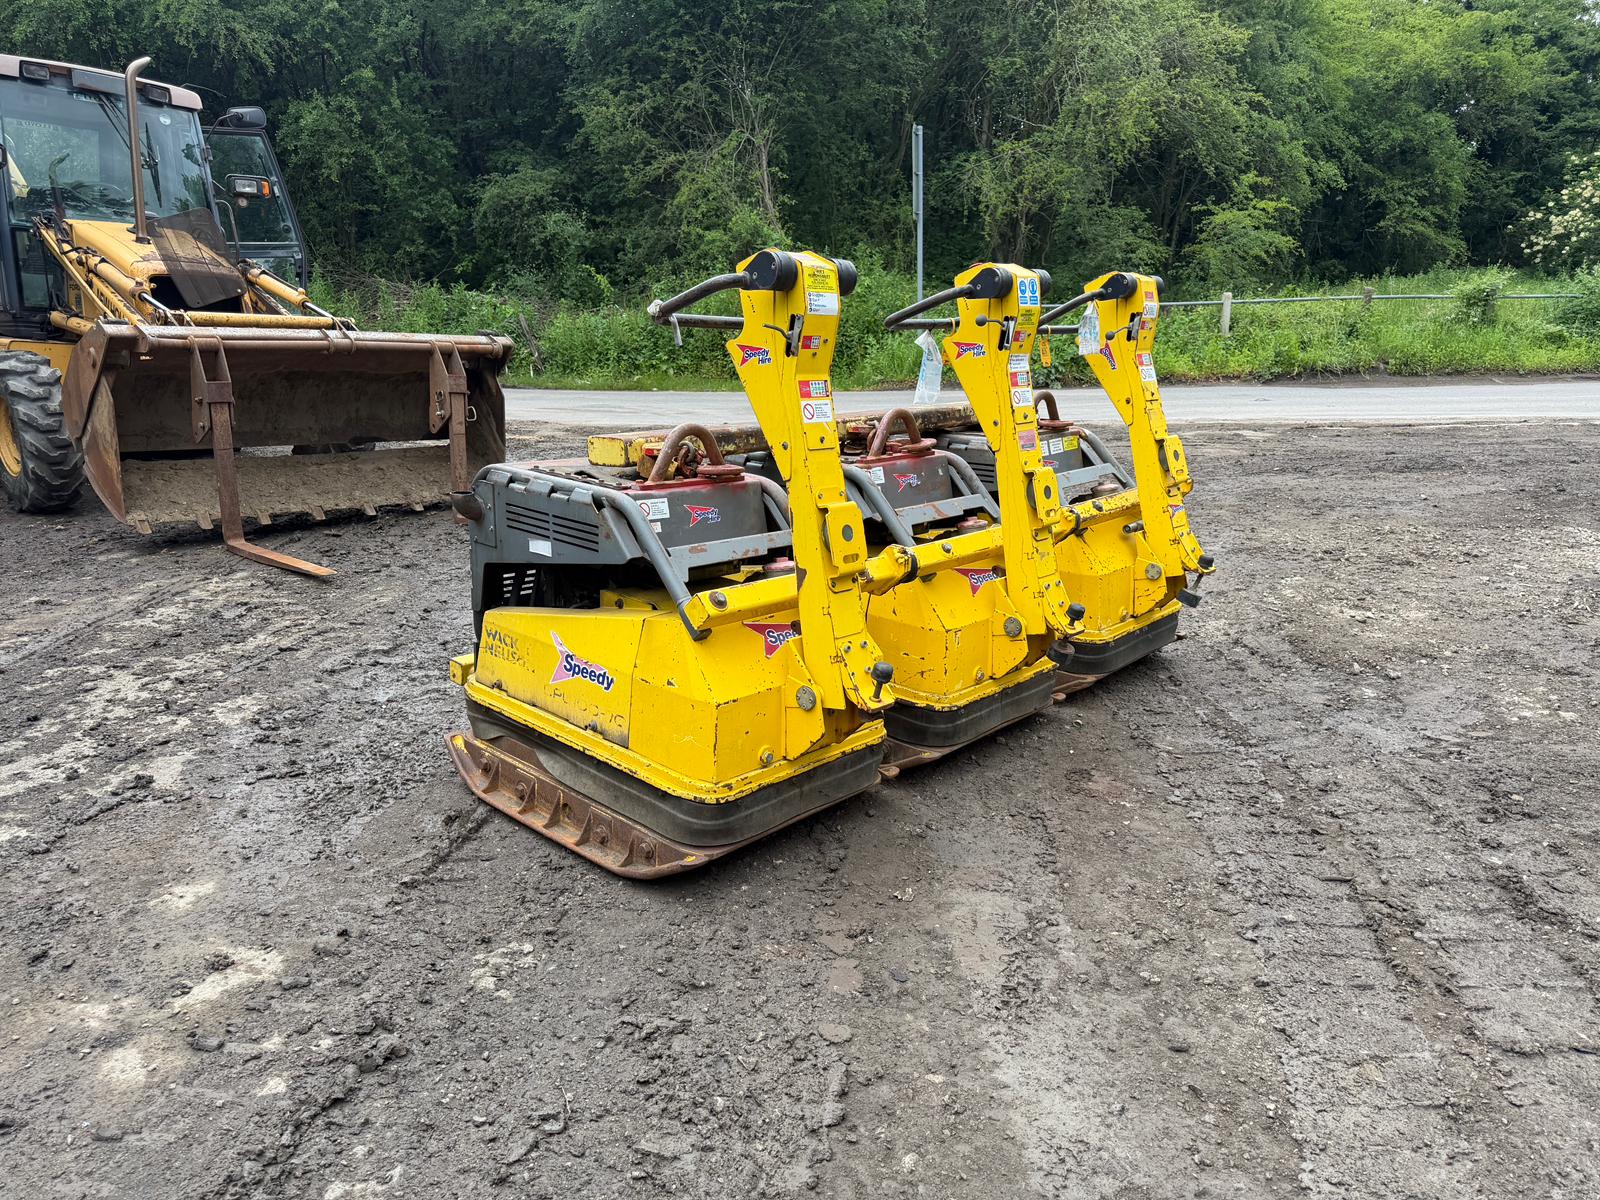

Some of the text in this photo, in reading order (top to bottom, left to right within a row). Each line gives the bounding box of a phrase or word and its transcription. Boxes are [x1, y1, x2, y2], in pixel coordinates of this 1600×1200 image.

[744, 349, 769, 360] Speedy
[757, 357, 772, 365] Hire
[969, 573, 999, 585] Speed
[563, 653, 615, 690] Speedy
